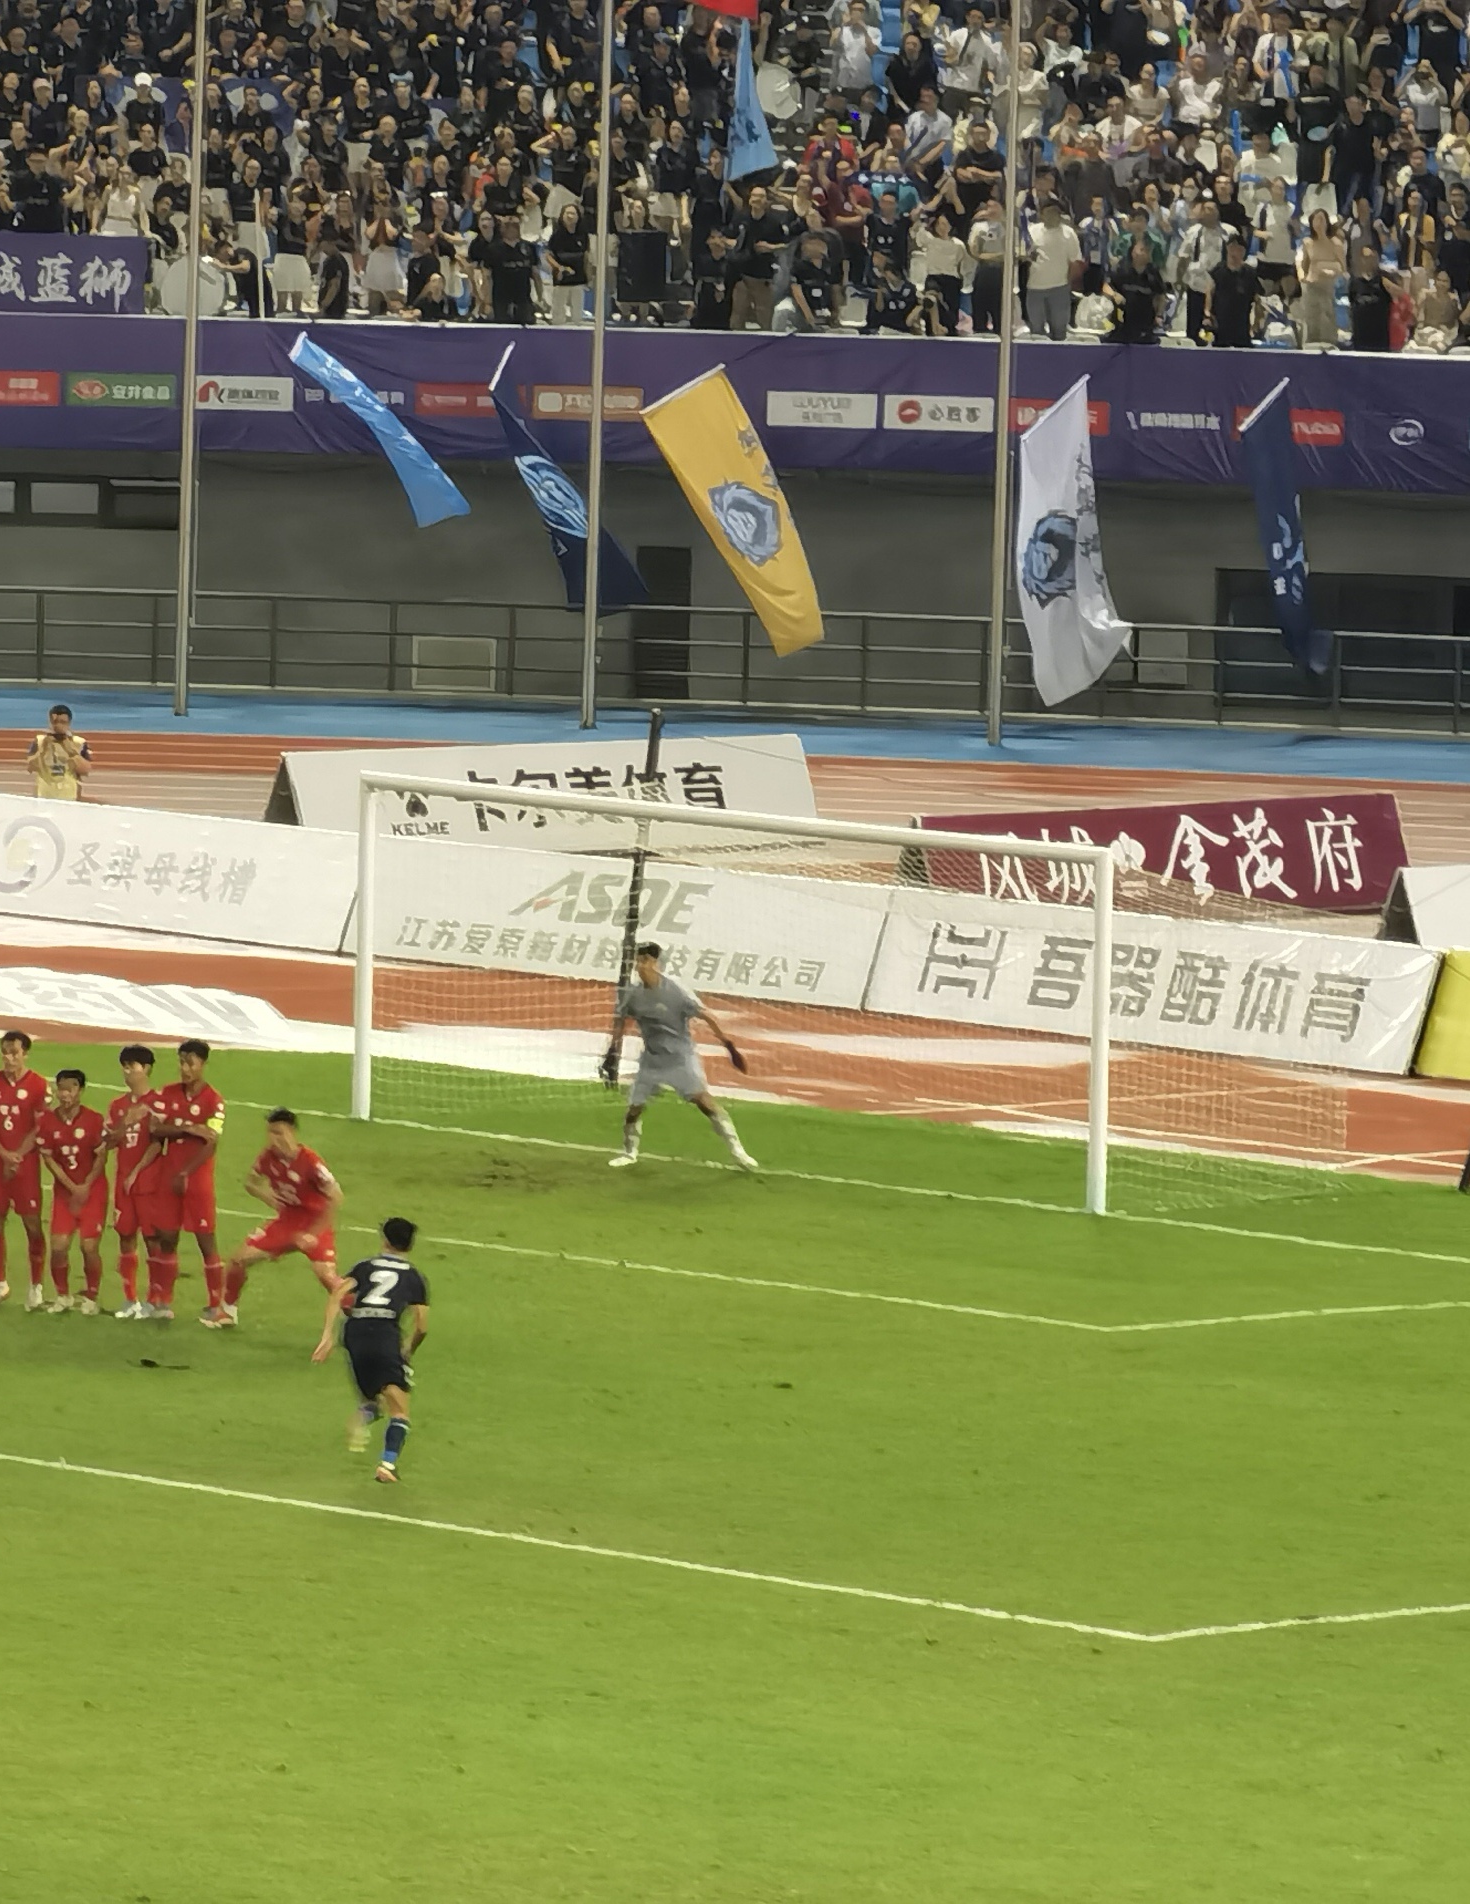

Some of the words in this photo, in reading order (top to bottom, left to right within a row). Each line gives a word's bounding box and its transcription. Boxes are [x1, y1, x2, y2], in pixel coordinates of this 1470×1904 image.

[391, 821, 450, 837] KELME
[1160, 808, 1364, 906] 金茂府
[368, 1270, 399, 1305] 2
